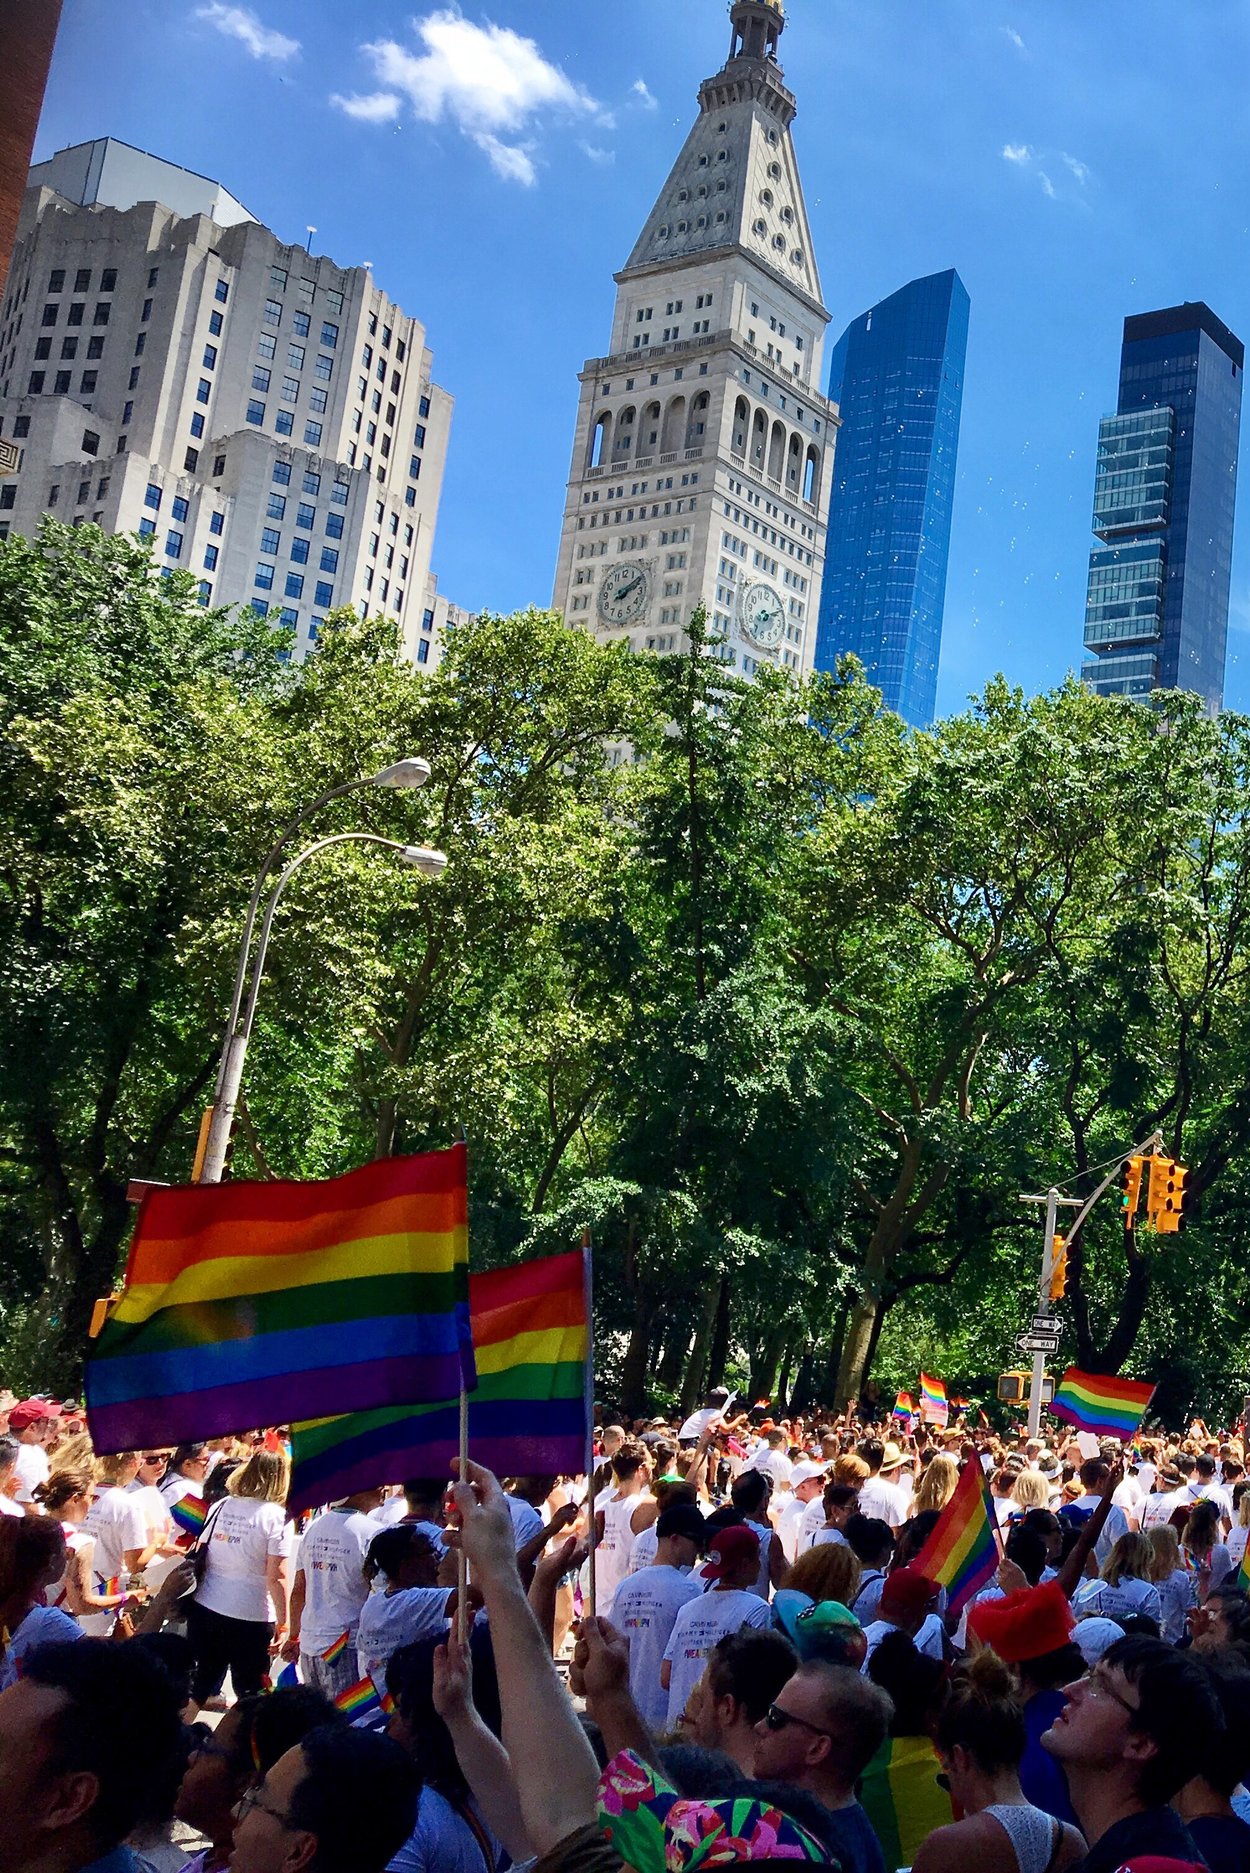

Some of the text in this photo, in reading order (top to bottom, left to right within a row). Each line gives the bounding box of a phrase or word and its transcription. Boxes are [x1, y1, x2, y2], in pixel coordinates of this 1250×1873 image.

[622, 569, 628, 578] 12
[614, 574, 620, 582] 11
[607, 582, 614, 591] 10
[638, 587, 642, 595] 3
[603, 592, 608, 600] 9
[604, 602, 609, 610] 8
[626, 606, 631, 614] 5
[610, 608, 615, 616] 7
